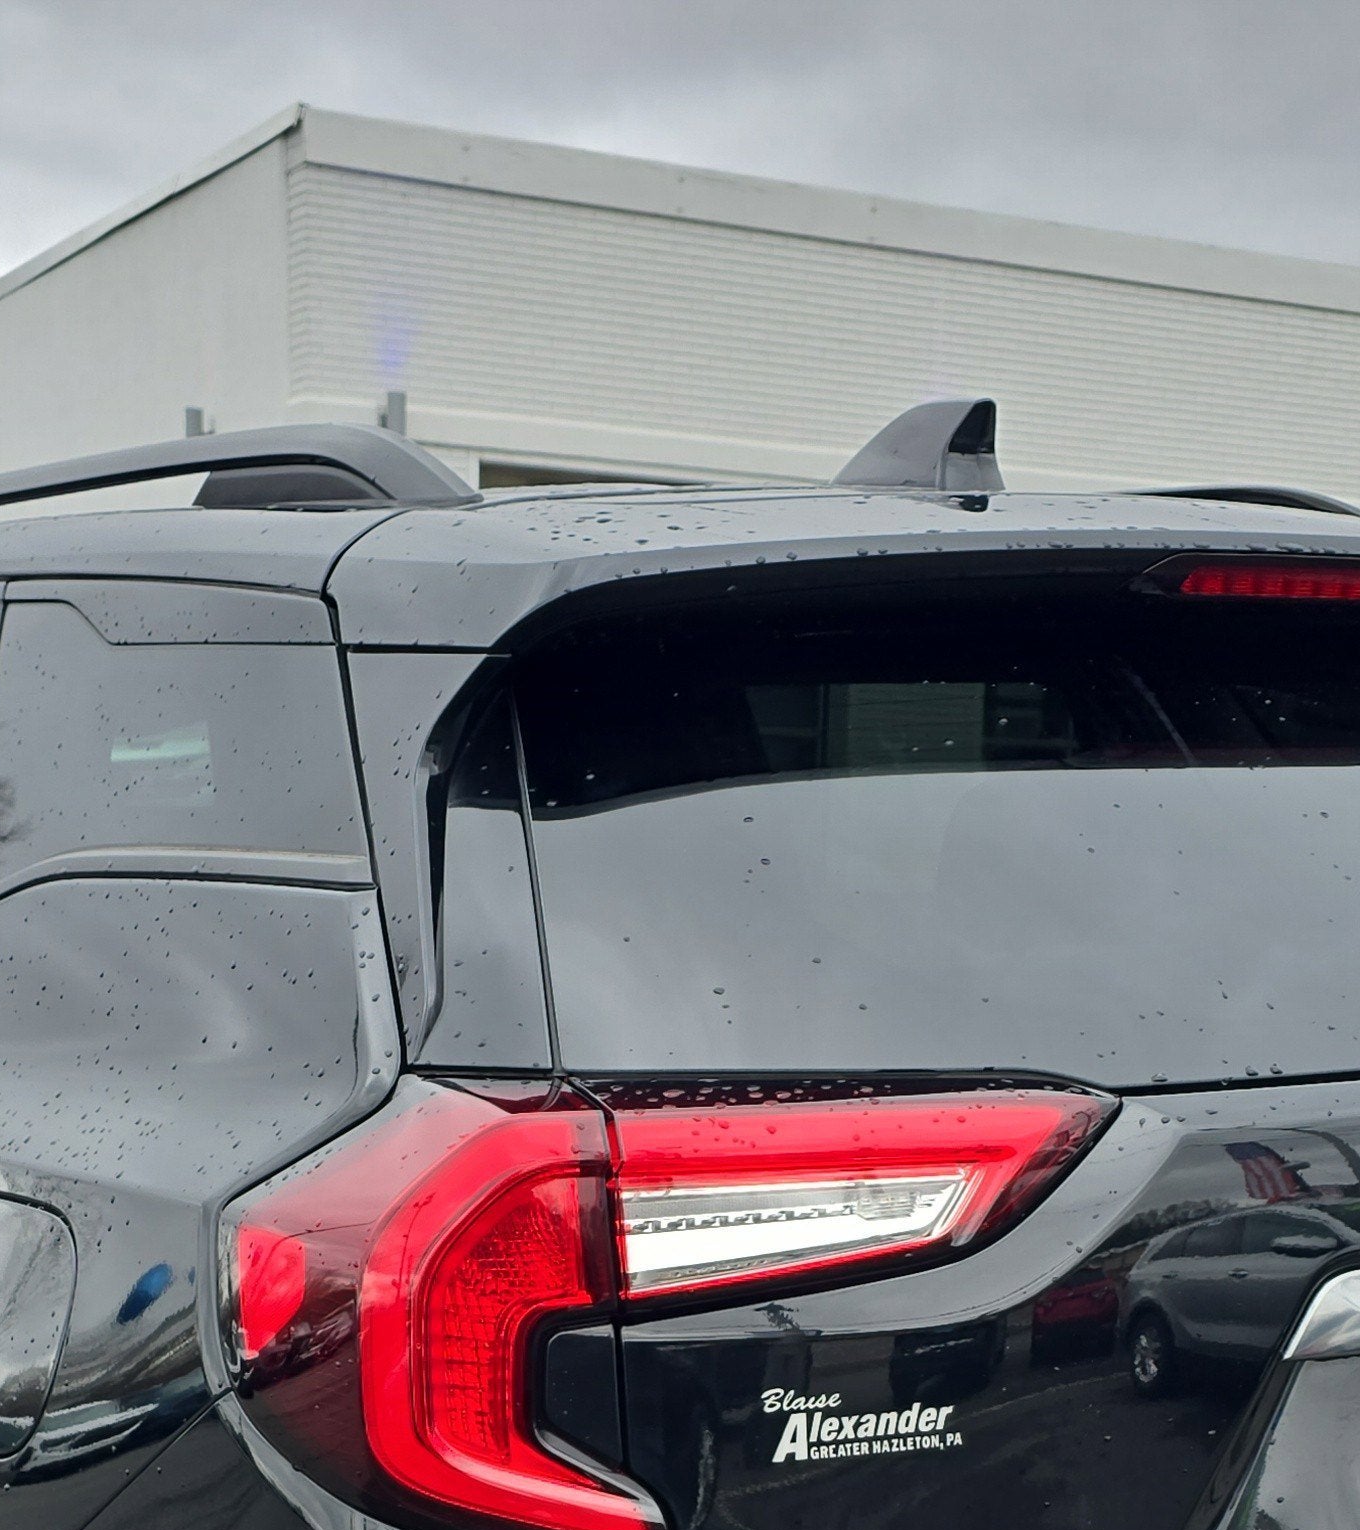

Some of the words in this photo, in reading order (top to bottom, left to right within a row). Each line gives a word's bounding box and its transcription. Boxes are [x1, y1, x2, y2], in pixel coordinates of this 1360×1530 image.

[760, 1388, 841, 1413] Blaise
[772, 1402, 954, 1463] Alexander
[810, 1442, 870, 1460] GREATER
[872, 1435, 944, 1453] HAZLETON,
[946, 1432, 963, 1446] PA
